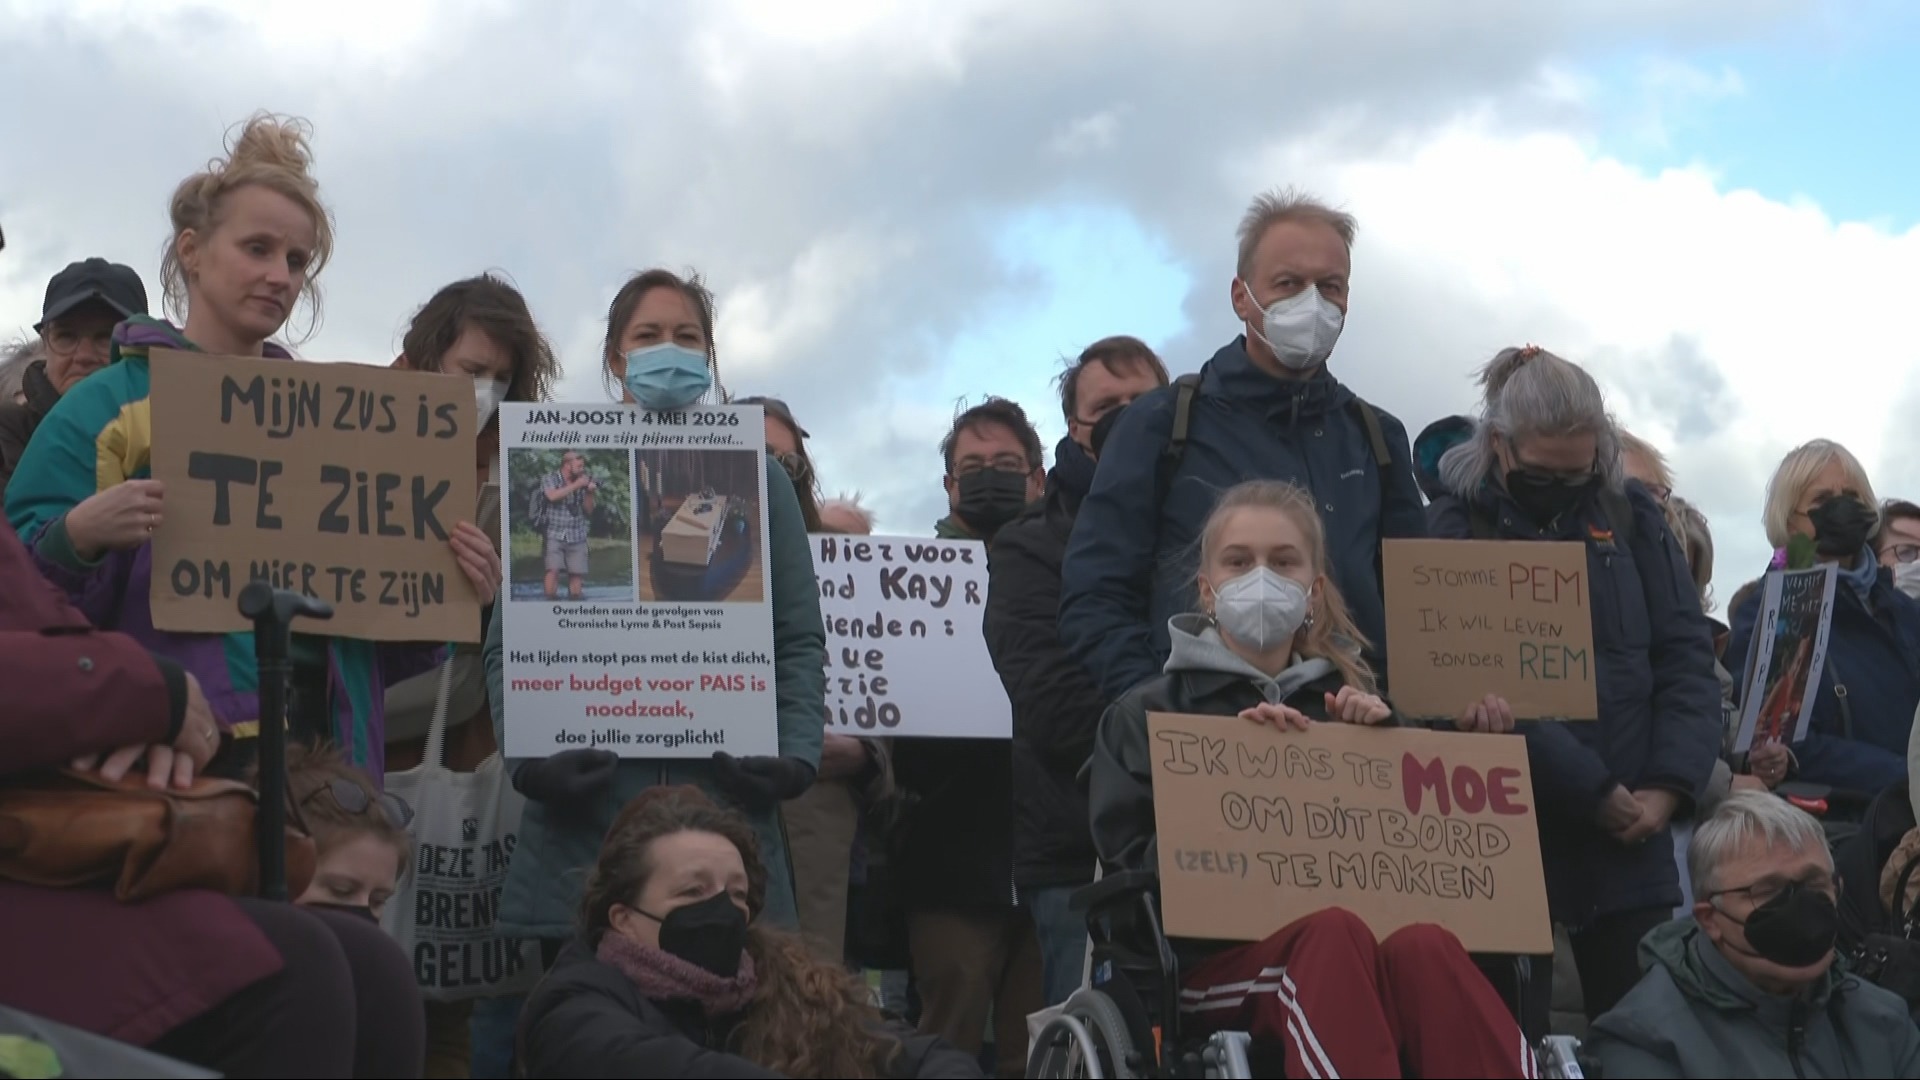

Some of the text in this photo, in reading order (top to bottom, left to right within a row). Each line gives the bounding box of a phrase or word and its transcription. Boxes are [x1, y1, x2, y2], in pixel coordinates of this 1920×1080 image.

[333, 386, 397, 433] ZUS
[525, 411, 624, 425] JAN-JOOST
[642, 412, 653, 425] 4
[657, 411, 687, 425] MEI
[693, 412, 739, 426] 2026
[521, 431, 581, 445] Eindelijk
[585, 433, 609, 443] van
[613, 432, 638, 446] zijn
[642, 432, 684, 446] pijnen
[188, 451, 283, 529] TE
[821, 537, 973, 563] Hier voor
[171, 559, 231, 599] OM
[325, 567, 366, 603] TE
[880, 566, 952, 608] KAY
[1509, 562, 1581, 607] PEM
[553, 605, 724, 618] Overleden aan de gevolgen van
[558, 619, 721, 631] Chronische Lyme & Post Sepsis
[1459, 615, 1493, 631] WIL
[1504, 616, 1563, 637] LEVEN
[510, 651, 771, 666] Het lijden stopt pas met de kist dicht,
[1520, 642, 1587, 681] REM
[511, 674, 766, 696] meer budget voor PAIS is
[585, 700, 694, 720] noodzaak,
[555, 729, 724, 747] doe jullie zorgplicht!
[1156, 730, 1528, 816] IK WAS TE MOE
[1221, 792, 1294, 837] OM
[1378, 808, 1510, 858] BORD
[418, 844, 475, 877] DEZE
[1175, 848, 1494, 900] (ZELF) TE MAKEN
[414, 937, 524, 987] GELUK
